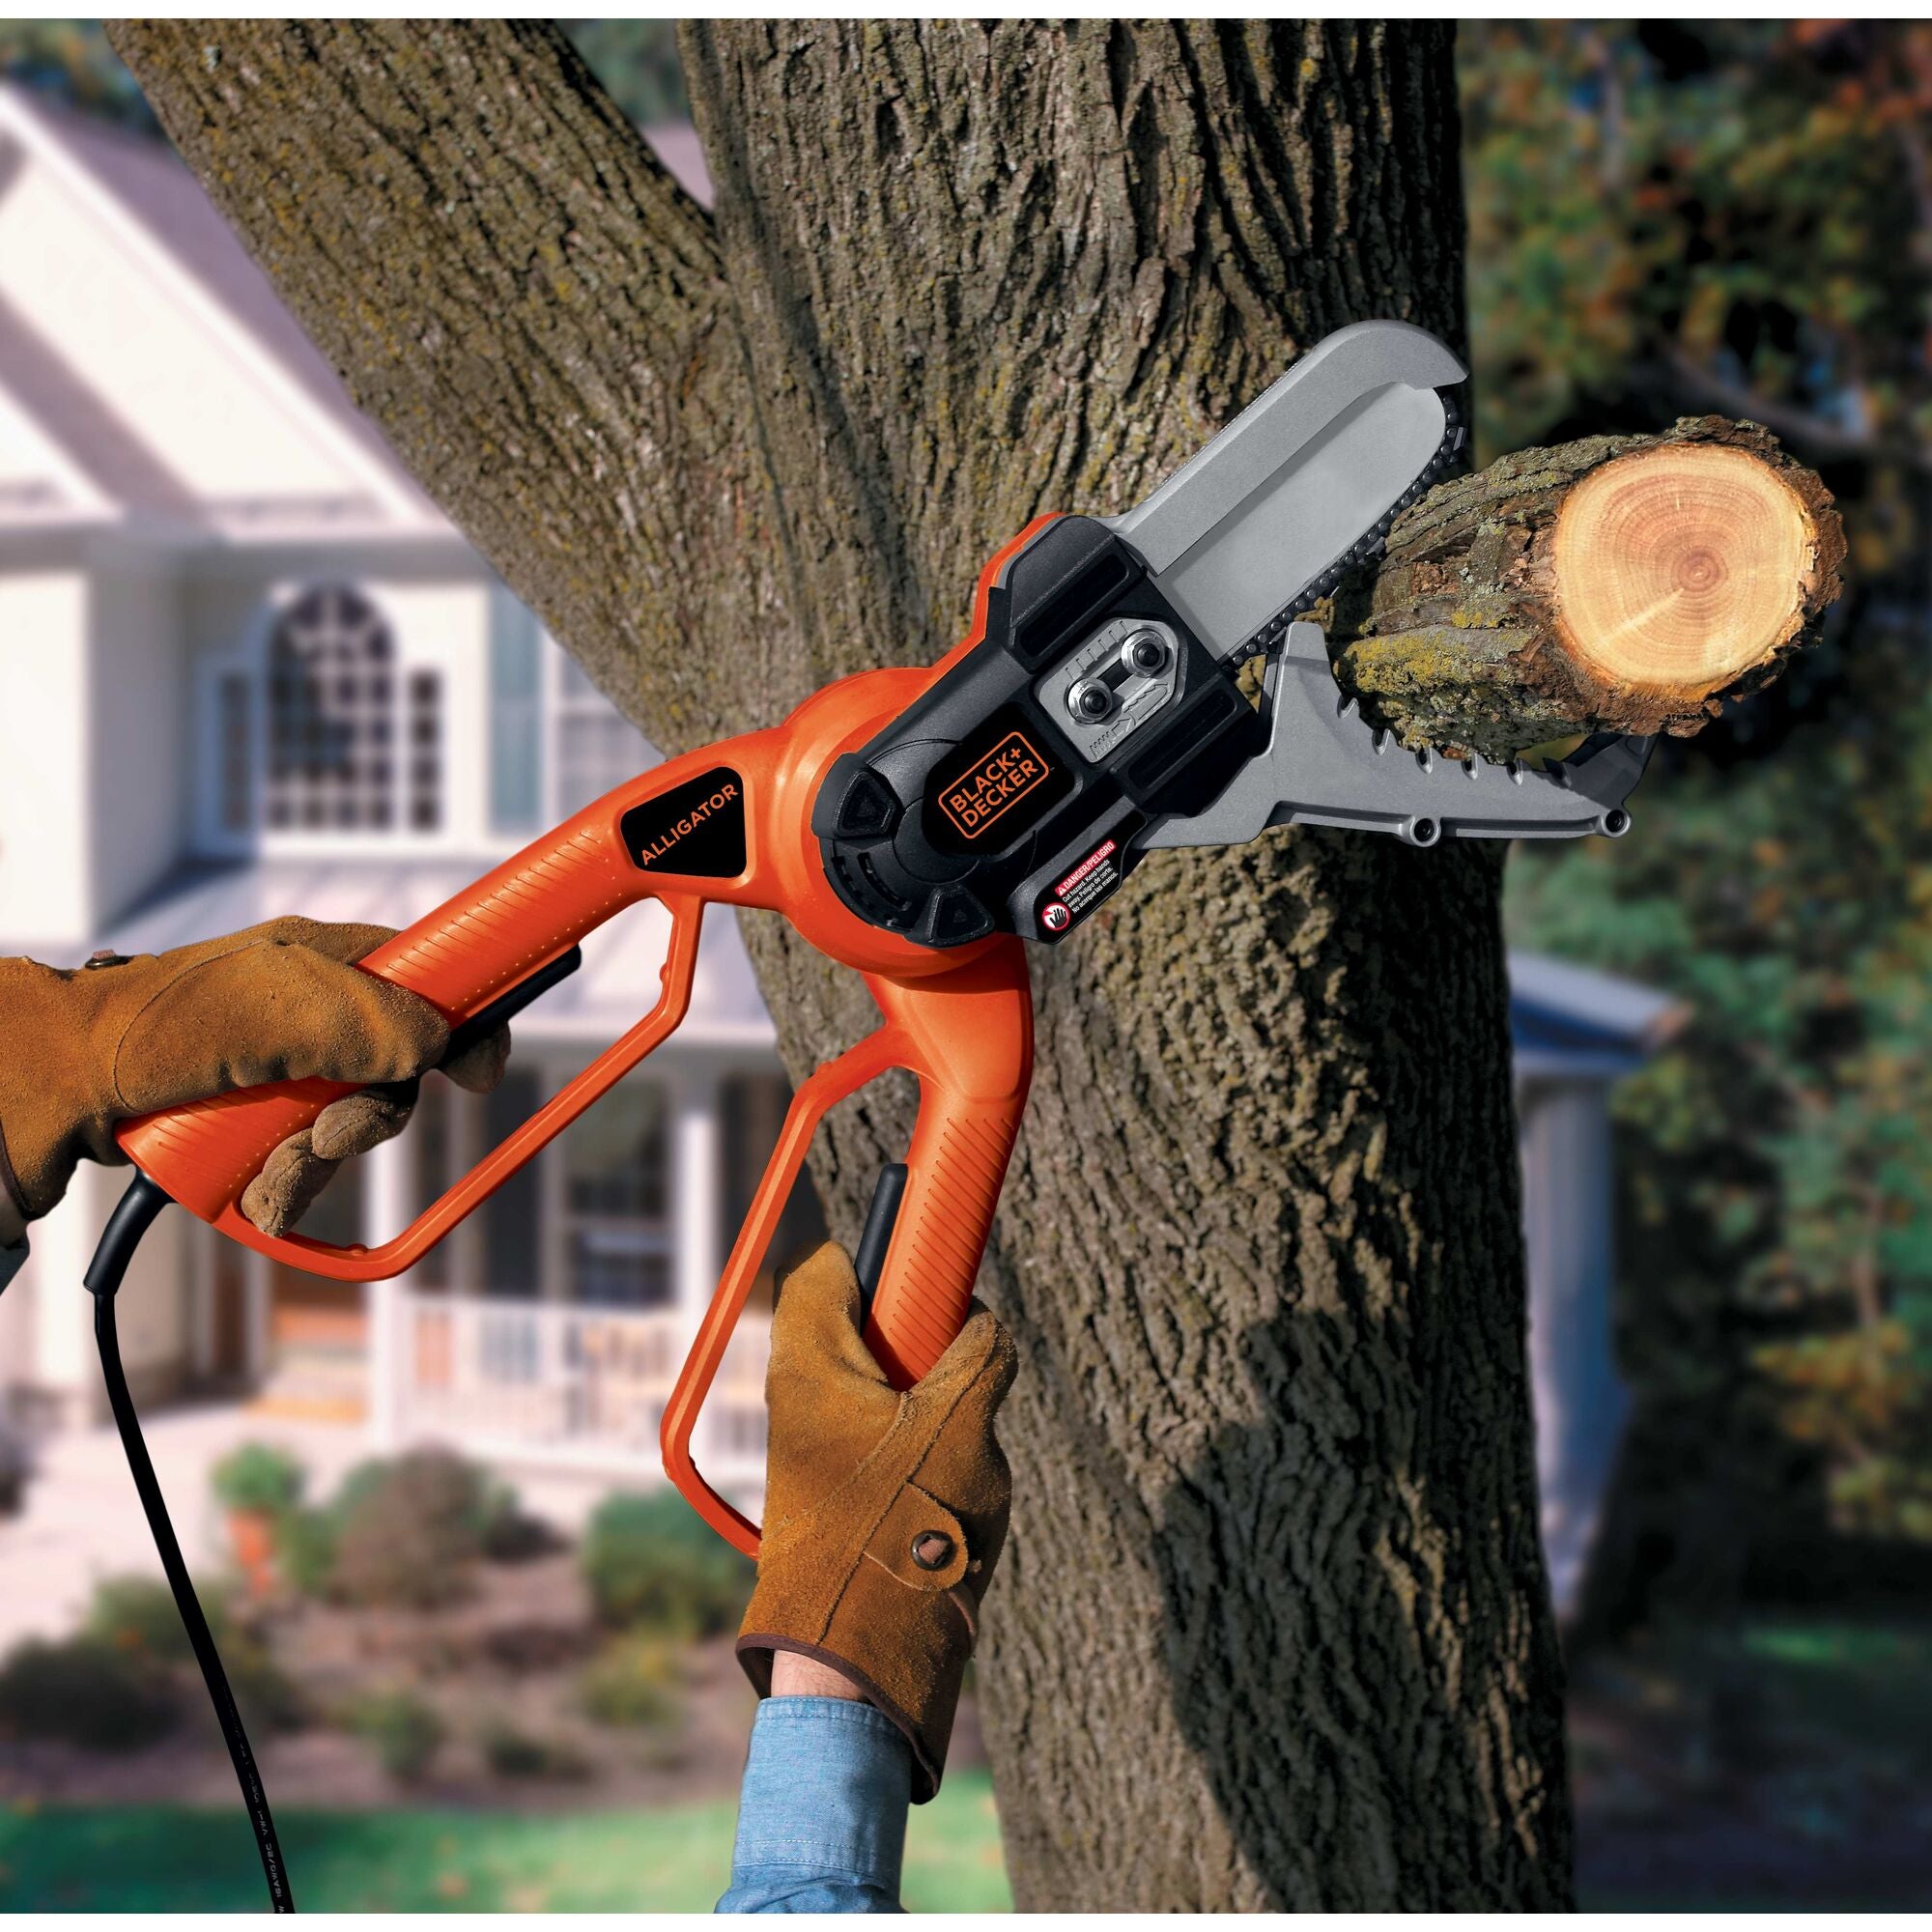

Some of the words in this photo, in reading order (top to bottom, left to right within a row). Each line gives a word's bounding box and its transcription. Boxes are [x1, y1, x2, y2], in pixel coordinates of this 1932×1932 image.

[950, 748, 1021, 813] BLACK+
[961, 759, 1038, 827] DECKER
[641, 783, 739, 866] ALLIGATOR
[1062, 894, 1071, 902] Cut
[1069, 880, 1087, 895] hazard.
[1085, 870, 1097, 883] Keep
[1095, 859, 1110, 873] hands
[1064, 841, 1115, 890] DANGER/PELIGRO
[1079, 883, 1094, 897] Peligro
[1094, 876, 1100, 885] de
[1099, 867, 1114, 879] corte.
[1094, 885, 1103, 894] las
[1102, 871, 1119, 887] manos.
